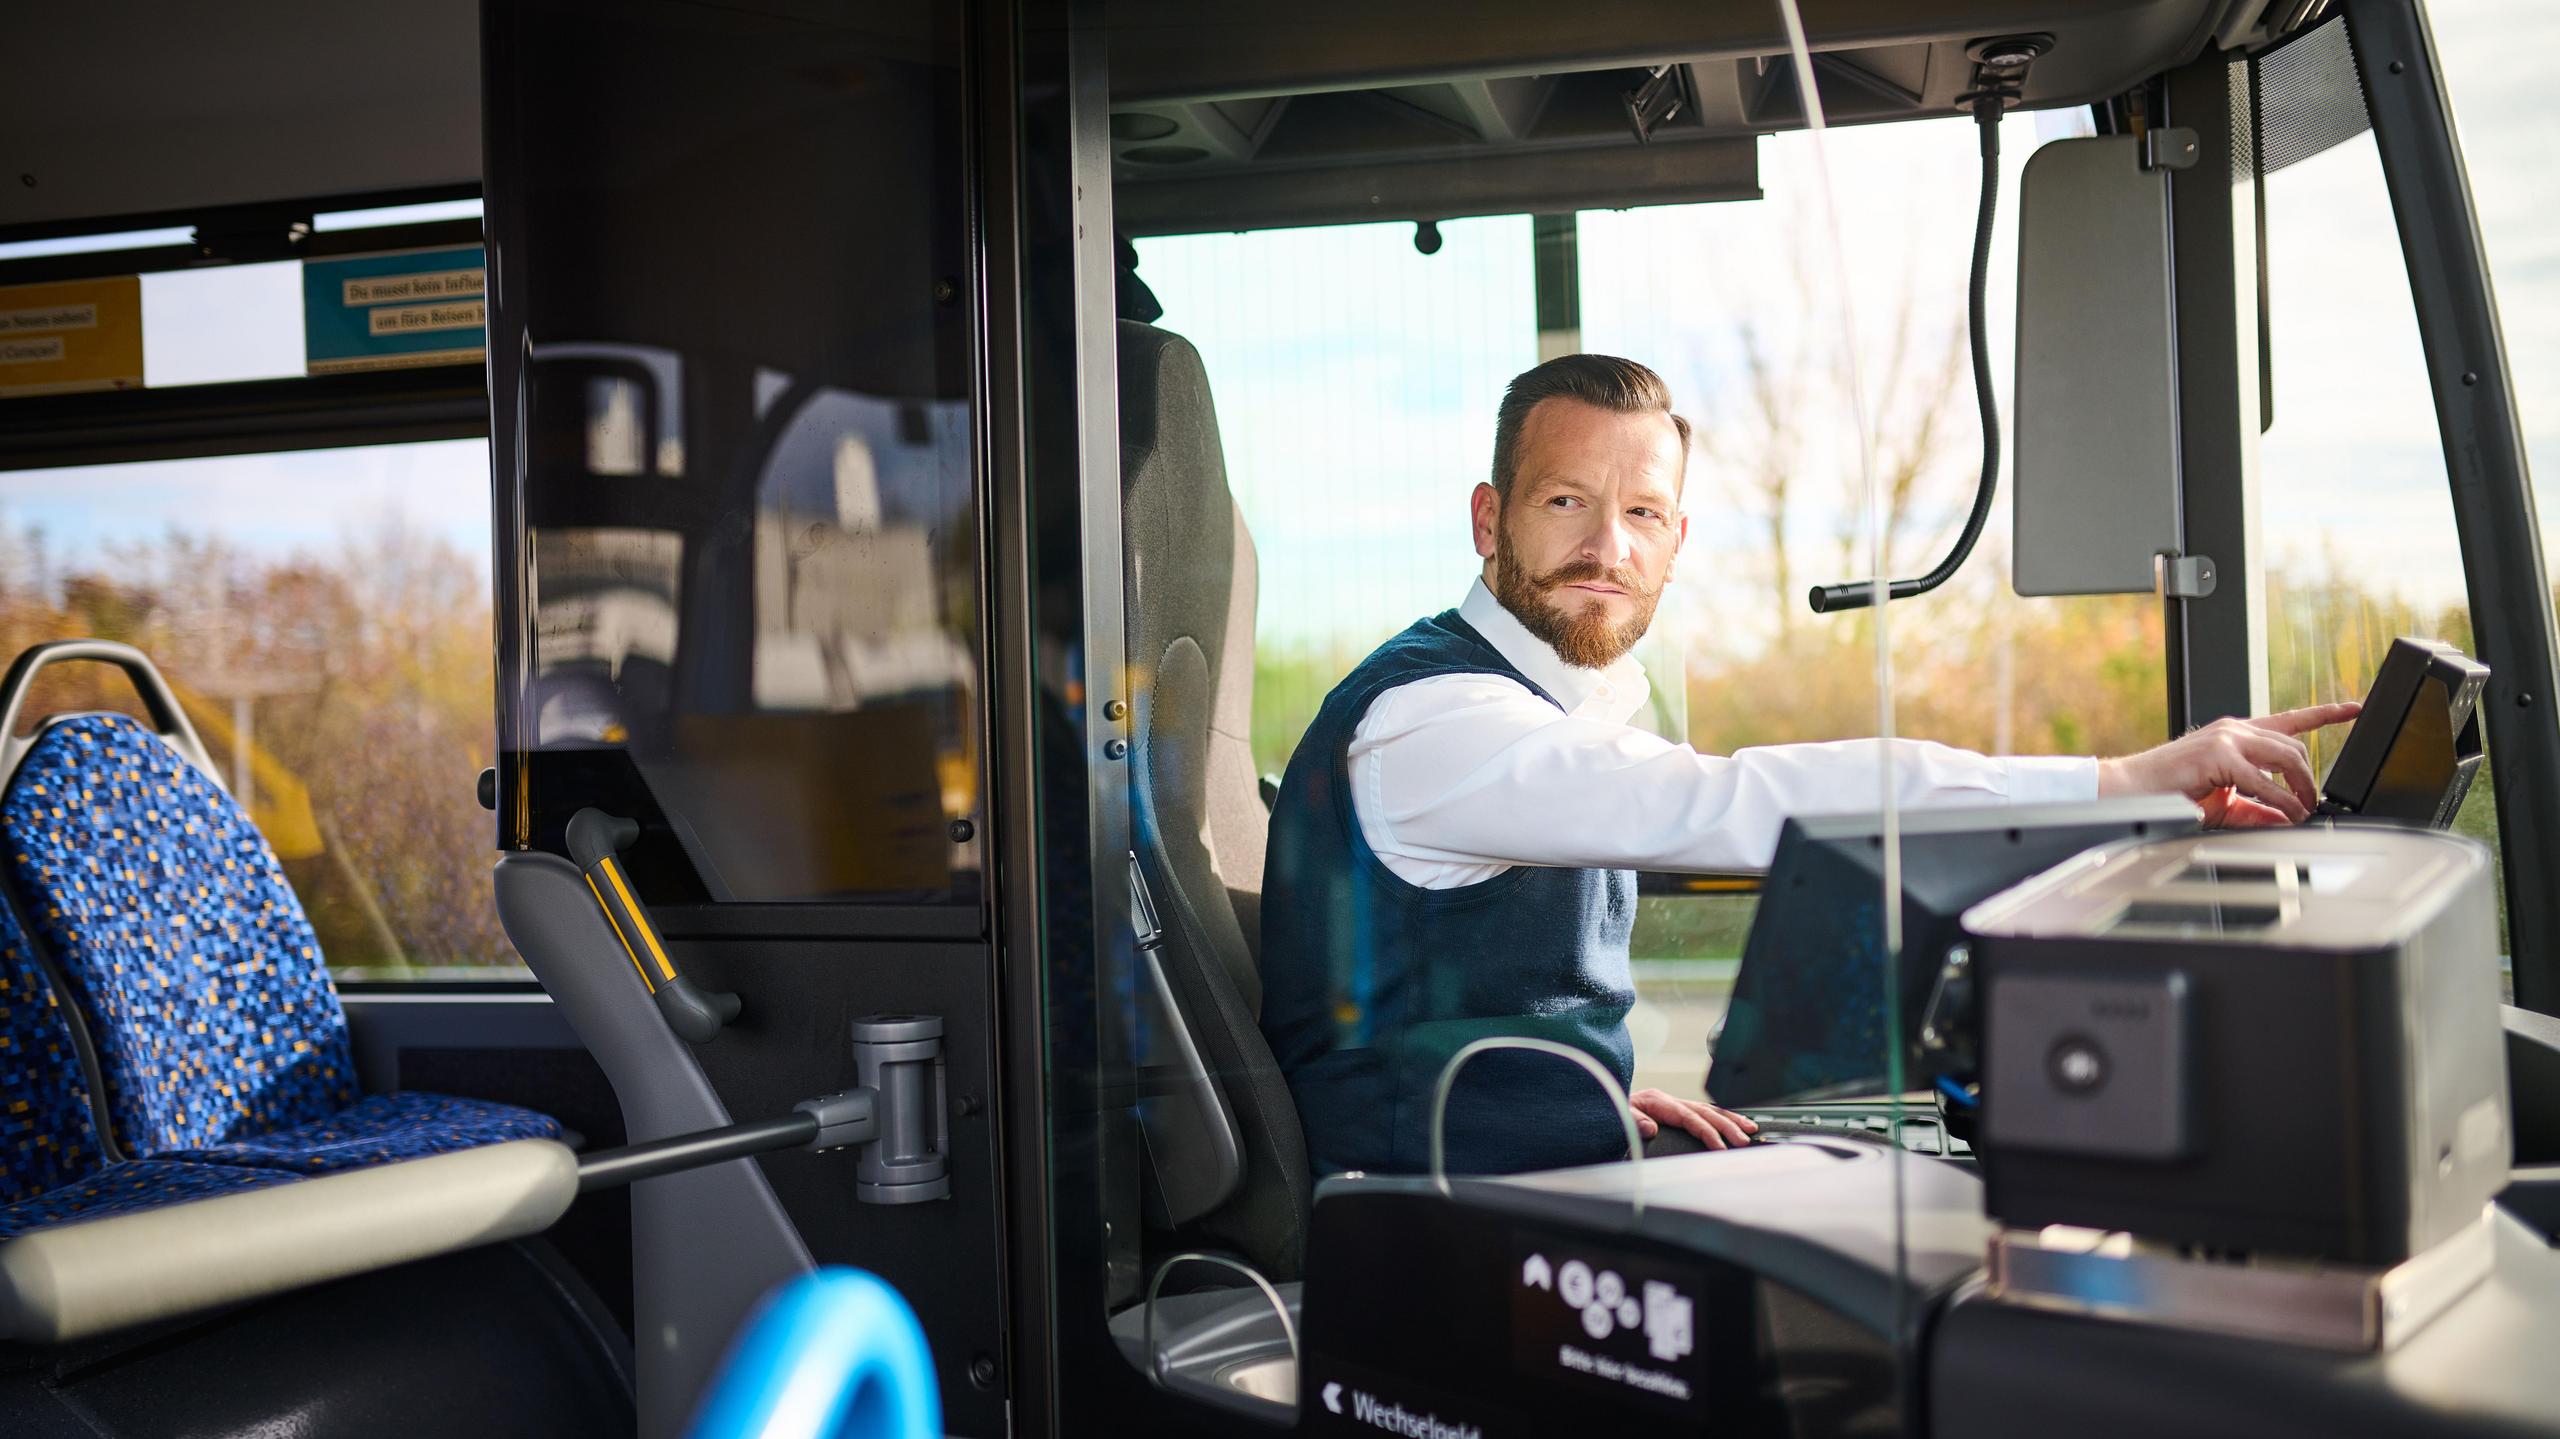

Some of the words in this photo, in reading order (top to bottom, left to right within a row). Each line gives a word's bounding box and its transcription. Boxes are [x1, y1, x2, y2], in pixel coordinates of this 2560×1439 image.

[350, 284, 368, 300] Du
[372, 282, 410, 298] musst
[413, 279, 442, 295] kein
[445, 273, 485, 291] Influe
[375, 316, 398, 330] um
[431, 305, 475, 324] Reisen
